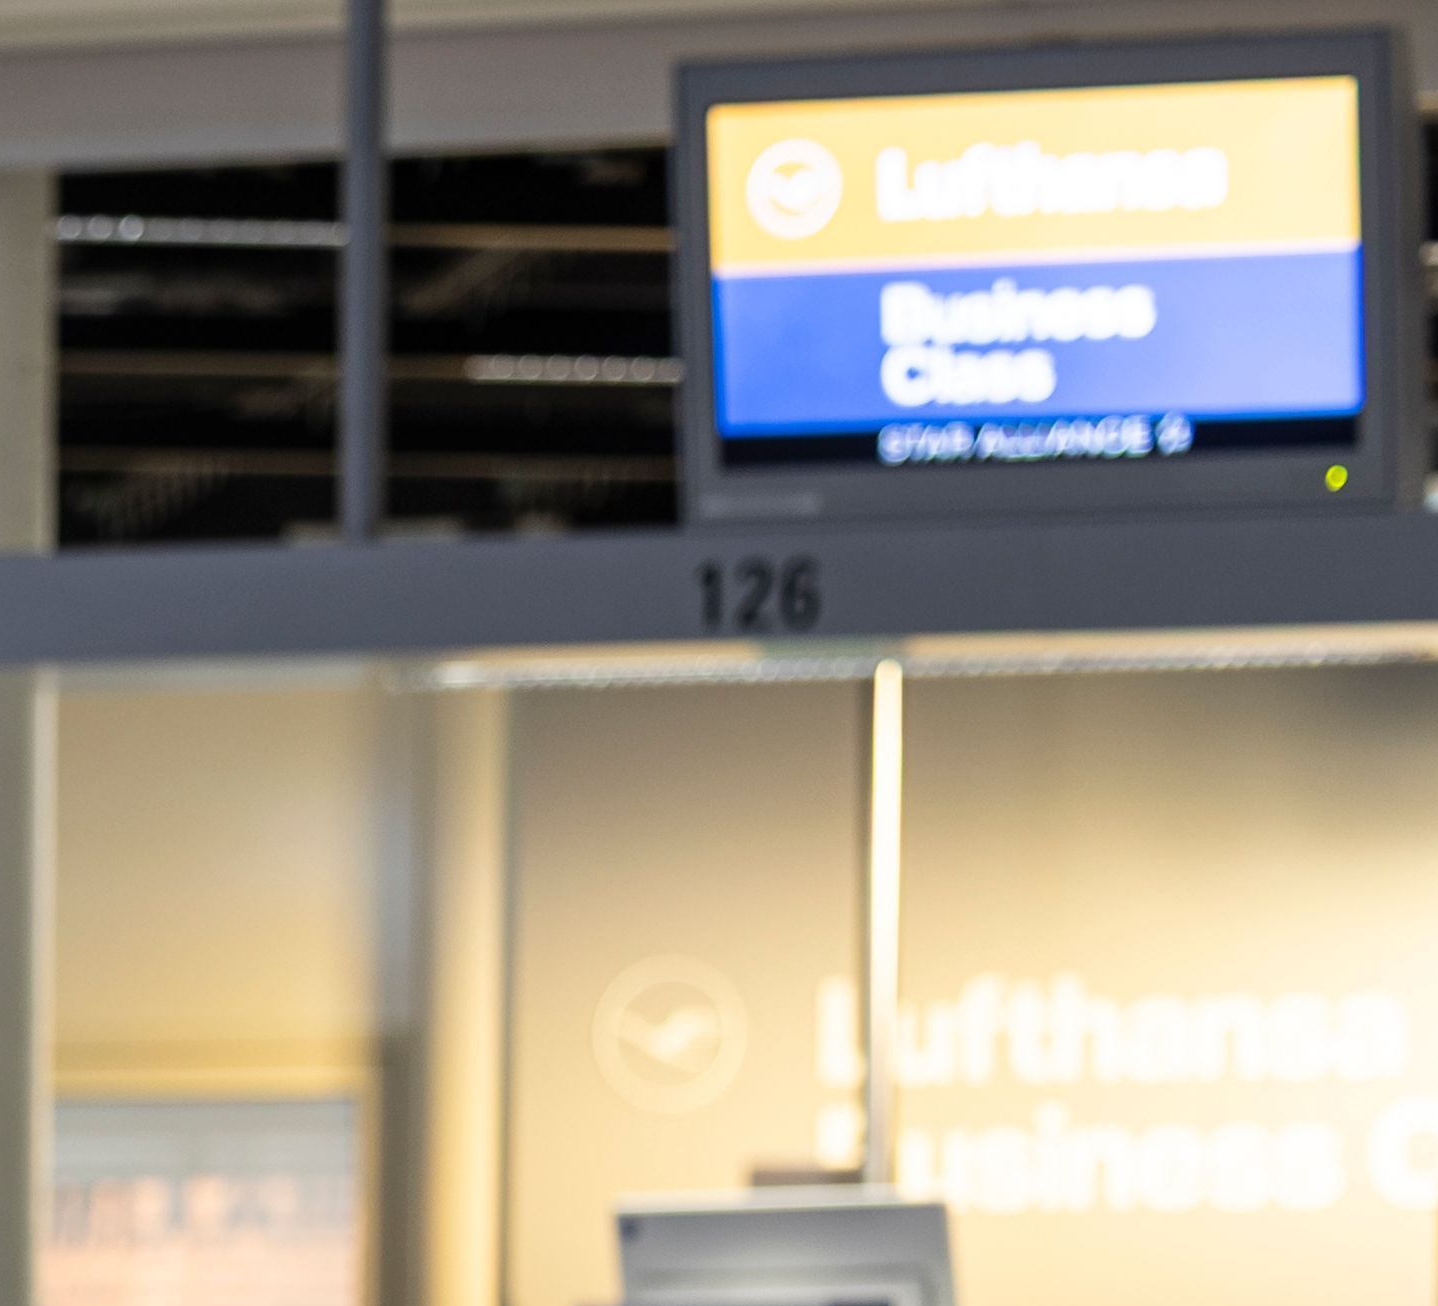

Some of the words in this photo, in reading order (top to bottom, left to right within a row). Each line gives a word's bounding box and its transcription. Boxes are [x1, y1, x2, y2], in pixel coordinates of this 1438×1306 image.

[875, 139, 1229, 222] Lufthansa
[880, 278, 1157, 347] Business
[881, 343, 1056, 406] Class
[694, 555, 823, 631] 126
